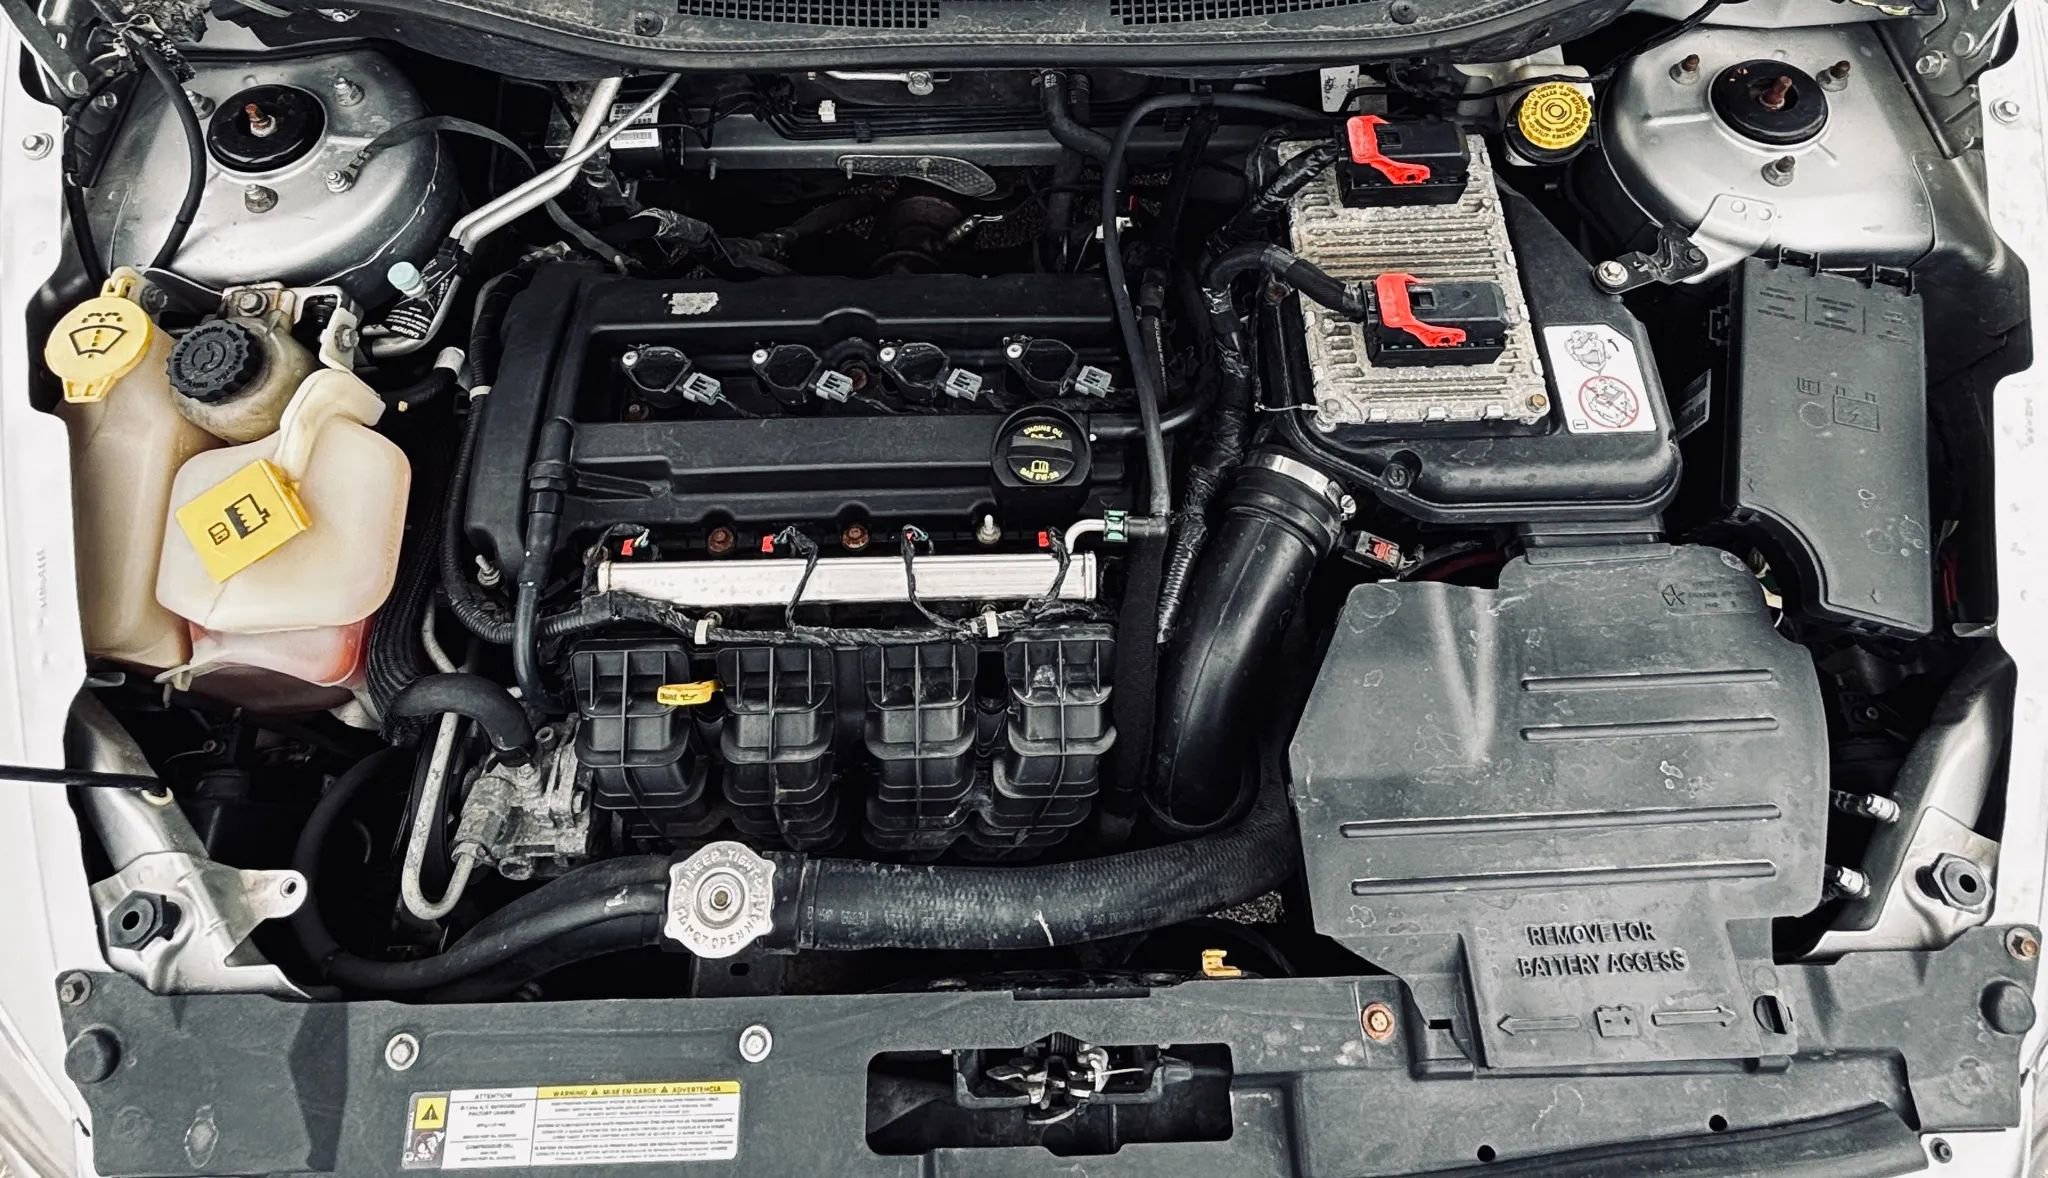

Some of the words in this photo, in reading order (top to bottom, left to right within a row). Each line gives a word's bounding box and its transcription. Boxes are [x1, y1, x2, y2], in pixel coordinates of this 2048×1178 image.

[1023, 425, 1052, 435] ENGINE
[1052, 427, 1063, 439] OIL
[1526, 923, 1609, 946] REMOVE
[1612, 920, 1656, 942] FOR
[1517, 953, 1600, 977] BATTERY
[1607, 949, 1688, 974] ACCESS
[553, 1090, 588, 1098] WARNING
[633, 1087, 657, 1095] GARDE
[672, 1085, 721, 1094] ADVERTENCIA
